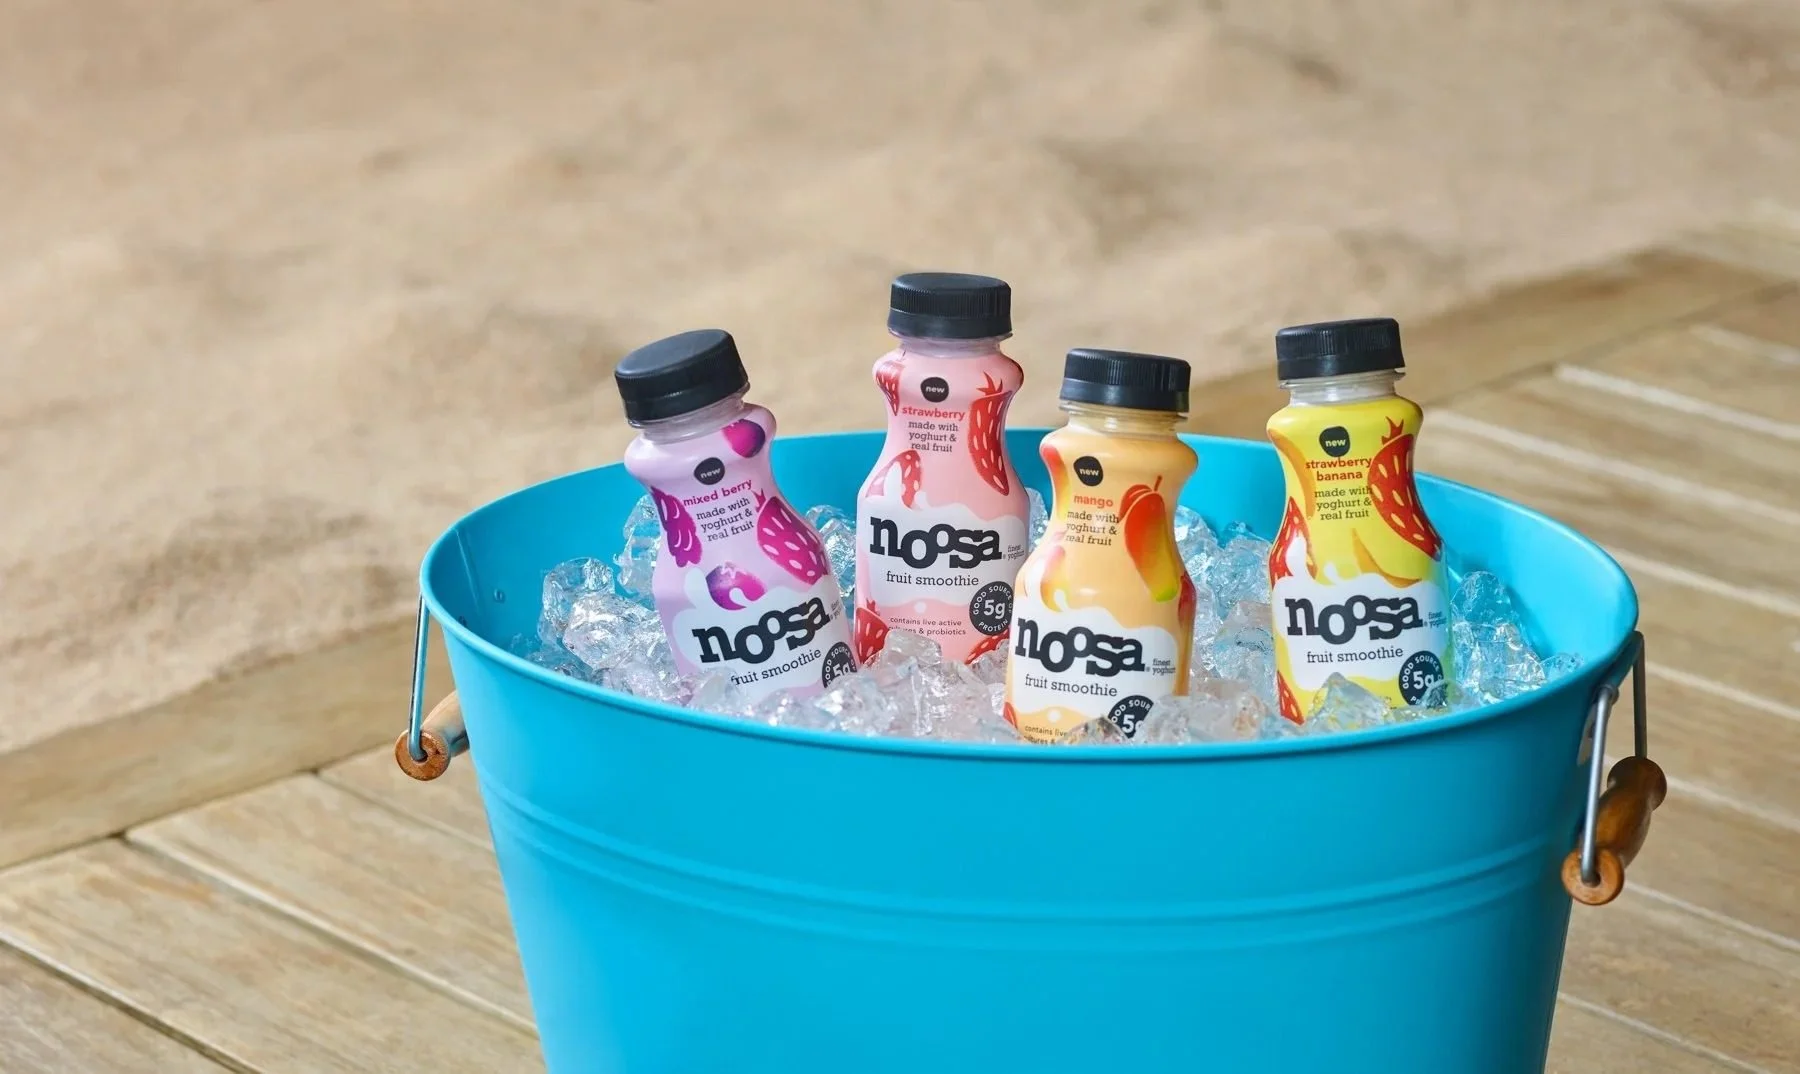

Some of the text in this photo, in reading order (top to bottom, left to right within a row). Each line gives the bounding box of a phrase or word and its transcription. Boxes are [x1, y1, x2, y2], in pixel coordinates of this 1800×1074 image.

[902, 406, 966, 421] strawberry
[908, 421, 959, 432] made with
[908, 432, 957, 442] yoghurt &
[1325, 439, 1346, 447] new
[911, 443, 953, 453] real fruit
[1305, 457, 1372, 469] strawberry
[700, 468, 720, 479] new
[1079, 468, 1100, 476] new
[1316, 471, 1363, 481] banana
[683, 480, 752, 506] mixed berry
[1314, 486, 1374, 498] made with
[696, 498, 751, 520] made with
[1073, 495, 1114, 509] mango
[1316, 497, 1372, 511] yoghurt &
[701, 508, 753, 533] yoghurt &
[1067, 511, 1120, 524] made with
[1320, 509, 1369, 520] real fruit
[707, 520, 754, 541] real fruit
[1066, 523, 1117, 535] yoghurt &
[869, 516, 1003, 569] noosa
[1065, 534, 1112, 546] real fruit
[886, 571, 979, 586] fruit smoothie
[973, 591, 987, 615] GOOD
[988, 585, 1012, 600] SOURCE
[983, 600, 1006, 620] 5g
[890, 617, 921, 625] contains
[922, 618, 936, 626] live
[978, 619, 1009, 632] PROTEIN
[1285, 594, 1423, 645] noosa
[692, 597, 831, 664] noosa
[926, 628, 966, 636] probiotics
[1014, 617, 1146, 677] noosa
[1307, 646, 1404, 663] fruit smoothie
[761, 649, 822, 680] smoothie
[825, 659, 833, 684] OOD
[1402, 662, 1414, 689] GOOD
[1415, 655, 1440, 671] SOURCE
[1025, 674, 1118, 697] fruit smoothie
[1111, 699, 1151, 723] OOD SOUR
[1024, 725, 1053, 735] contains
